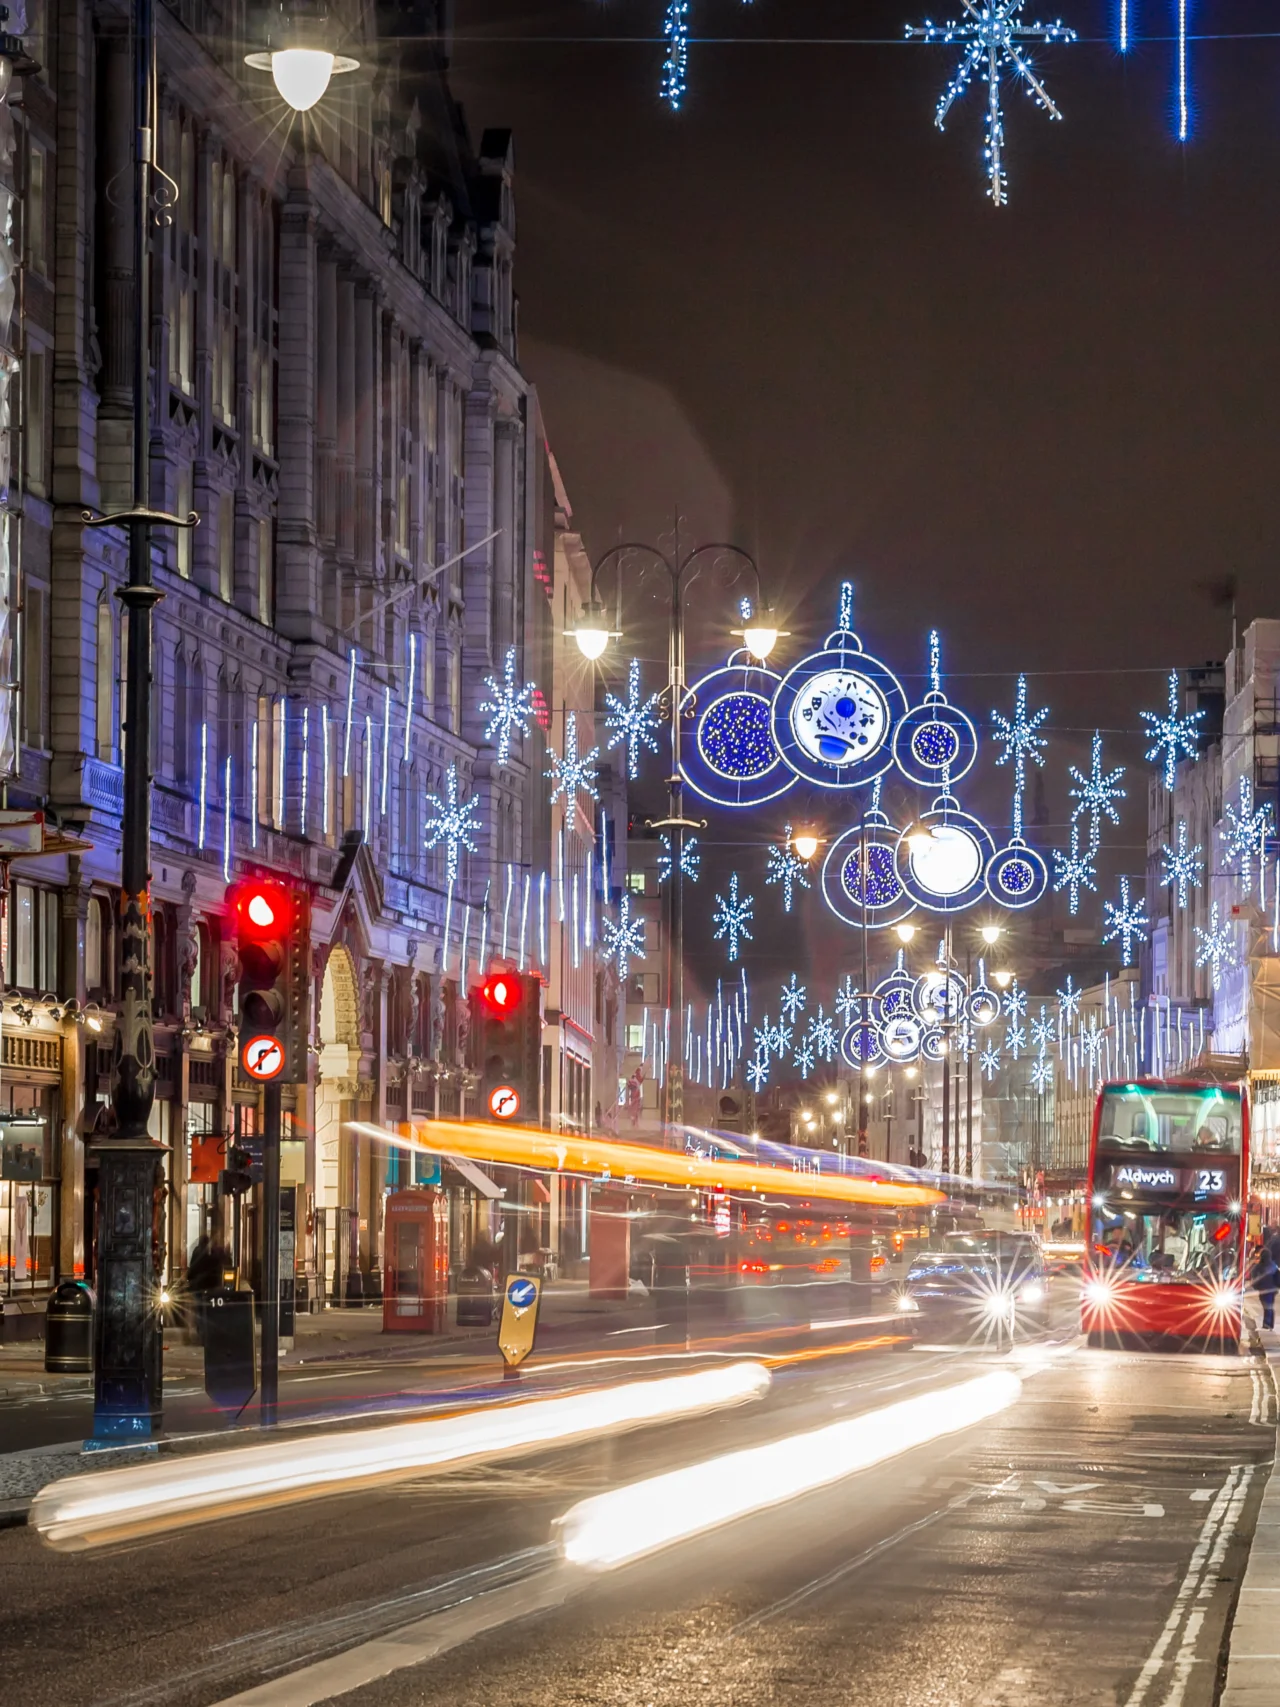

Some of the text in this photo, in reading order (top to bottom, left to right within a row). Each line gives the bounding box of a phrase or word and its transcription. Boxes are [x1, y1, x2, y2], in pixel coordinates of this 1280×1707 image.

[1117, 1167, 1174, 1186] Aldwych
[1199, 1170, 1224, 1191] 23
[210, 1297, 224, 1308] 10
